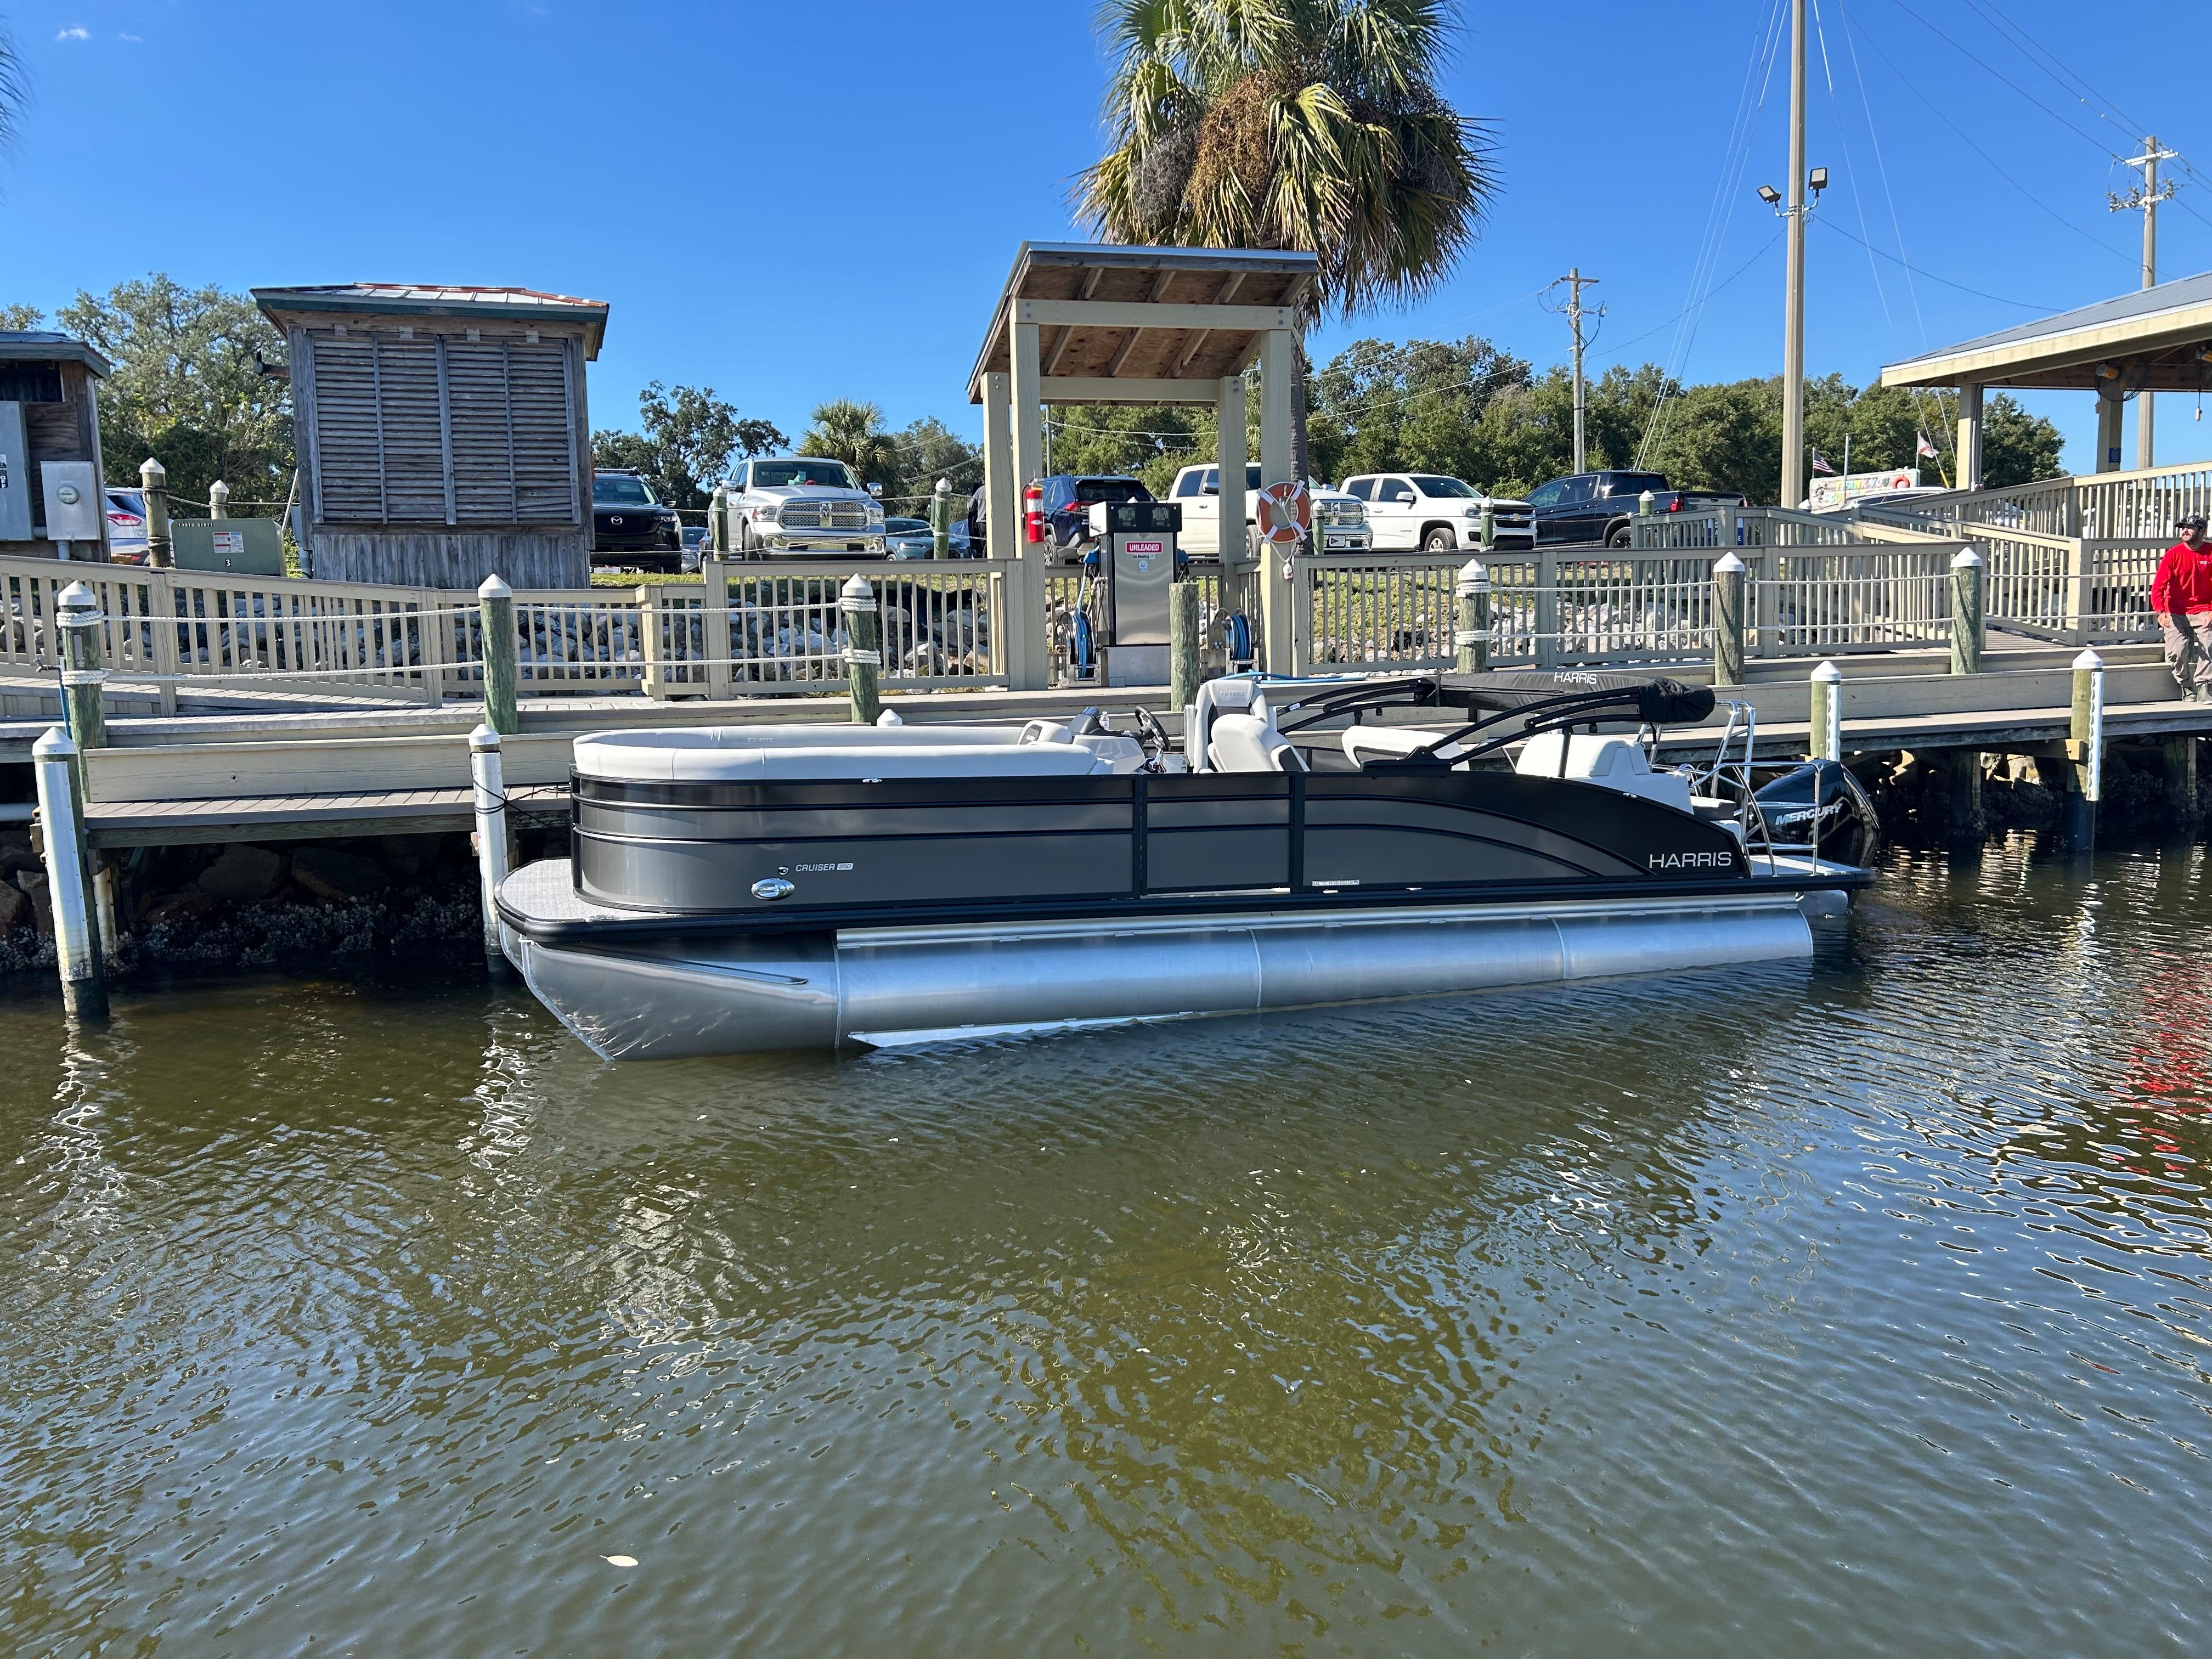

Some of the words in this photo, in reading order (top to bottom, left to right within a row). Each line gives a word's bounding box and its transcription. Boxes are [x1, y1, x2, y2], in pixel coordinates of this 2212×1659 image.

[1869, 477, 1890, 488] YOU
[225, 558, 230, 567] 3
[1554, 671, 1597, 685] HARRIS
[1775, 803, 1843, 826] MERCURY
[1649, 851, 1732, 868] HARRIS
[795, 863, 836, 872] CRUISER
